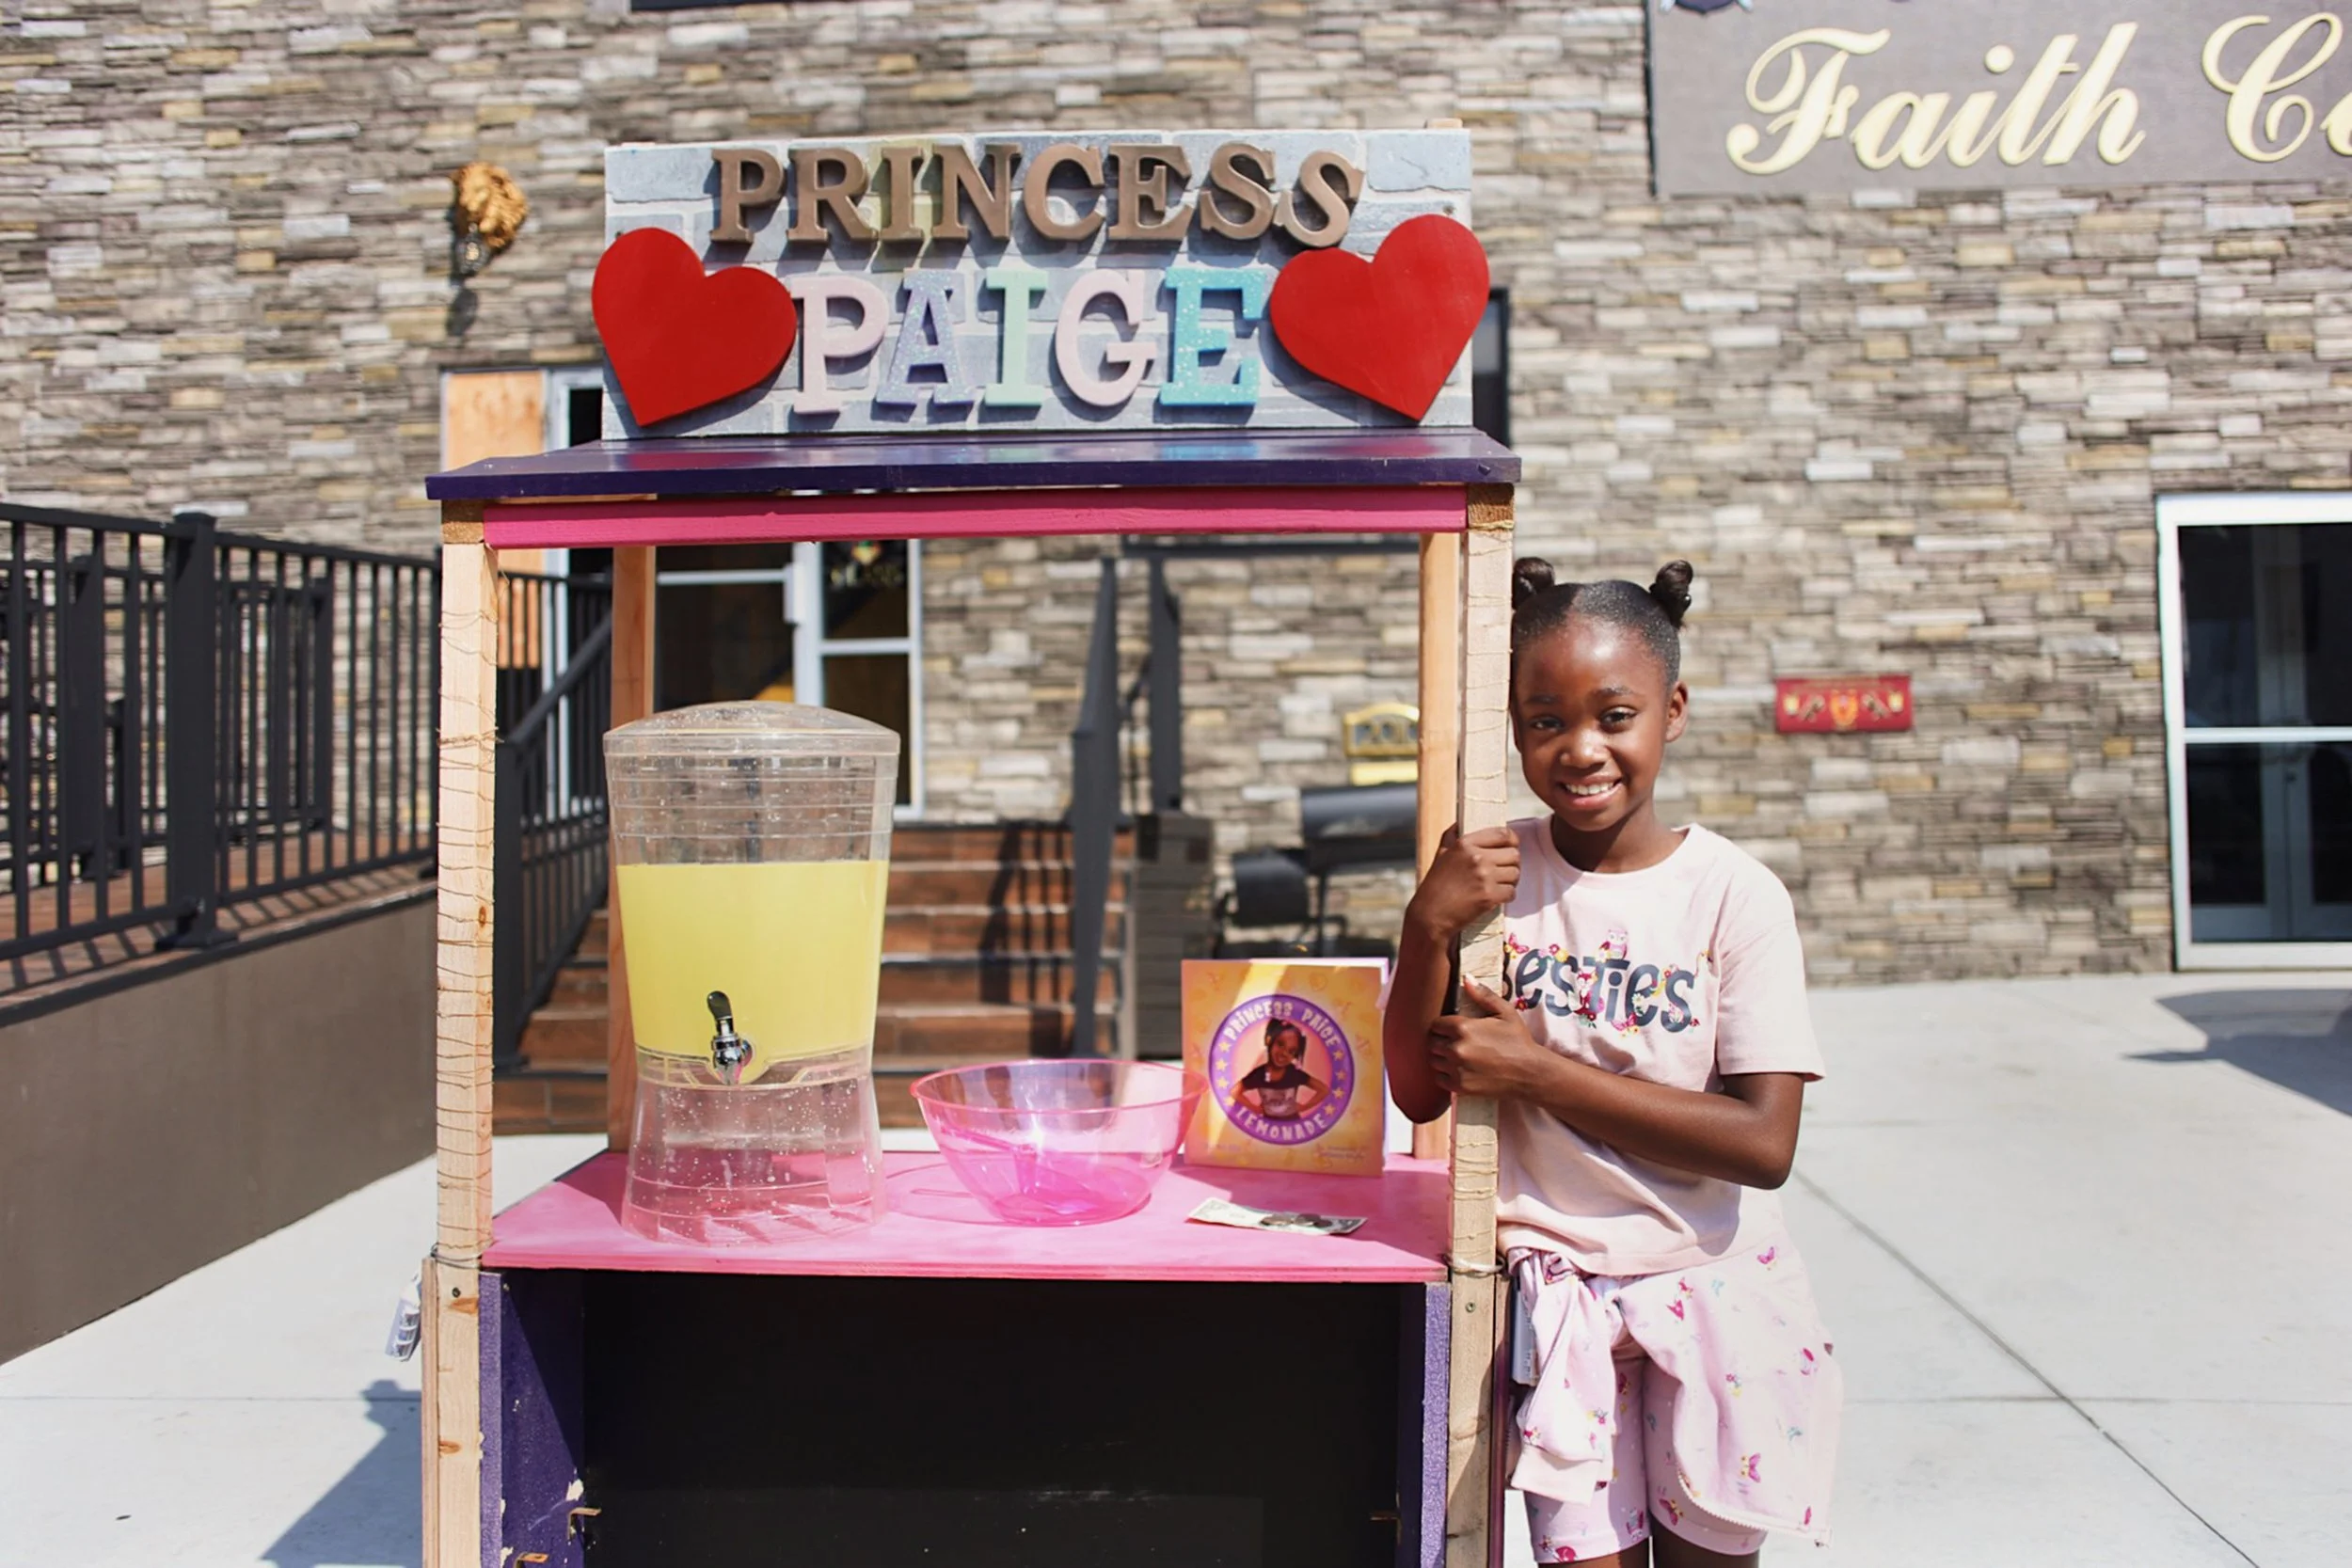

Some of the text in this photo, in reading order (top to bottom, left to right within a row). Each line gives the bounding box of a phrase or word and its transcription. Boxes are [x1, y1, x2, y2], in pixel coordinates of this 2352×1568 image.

[1726, 22, 2147, 175] Faith
[708, 141, 1365, 247] PRINCESS
[789, 266, 1270, 416] PAIGE
[1235, 1105, 1328, 1141] LEMONADE
